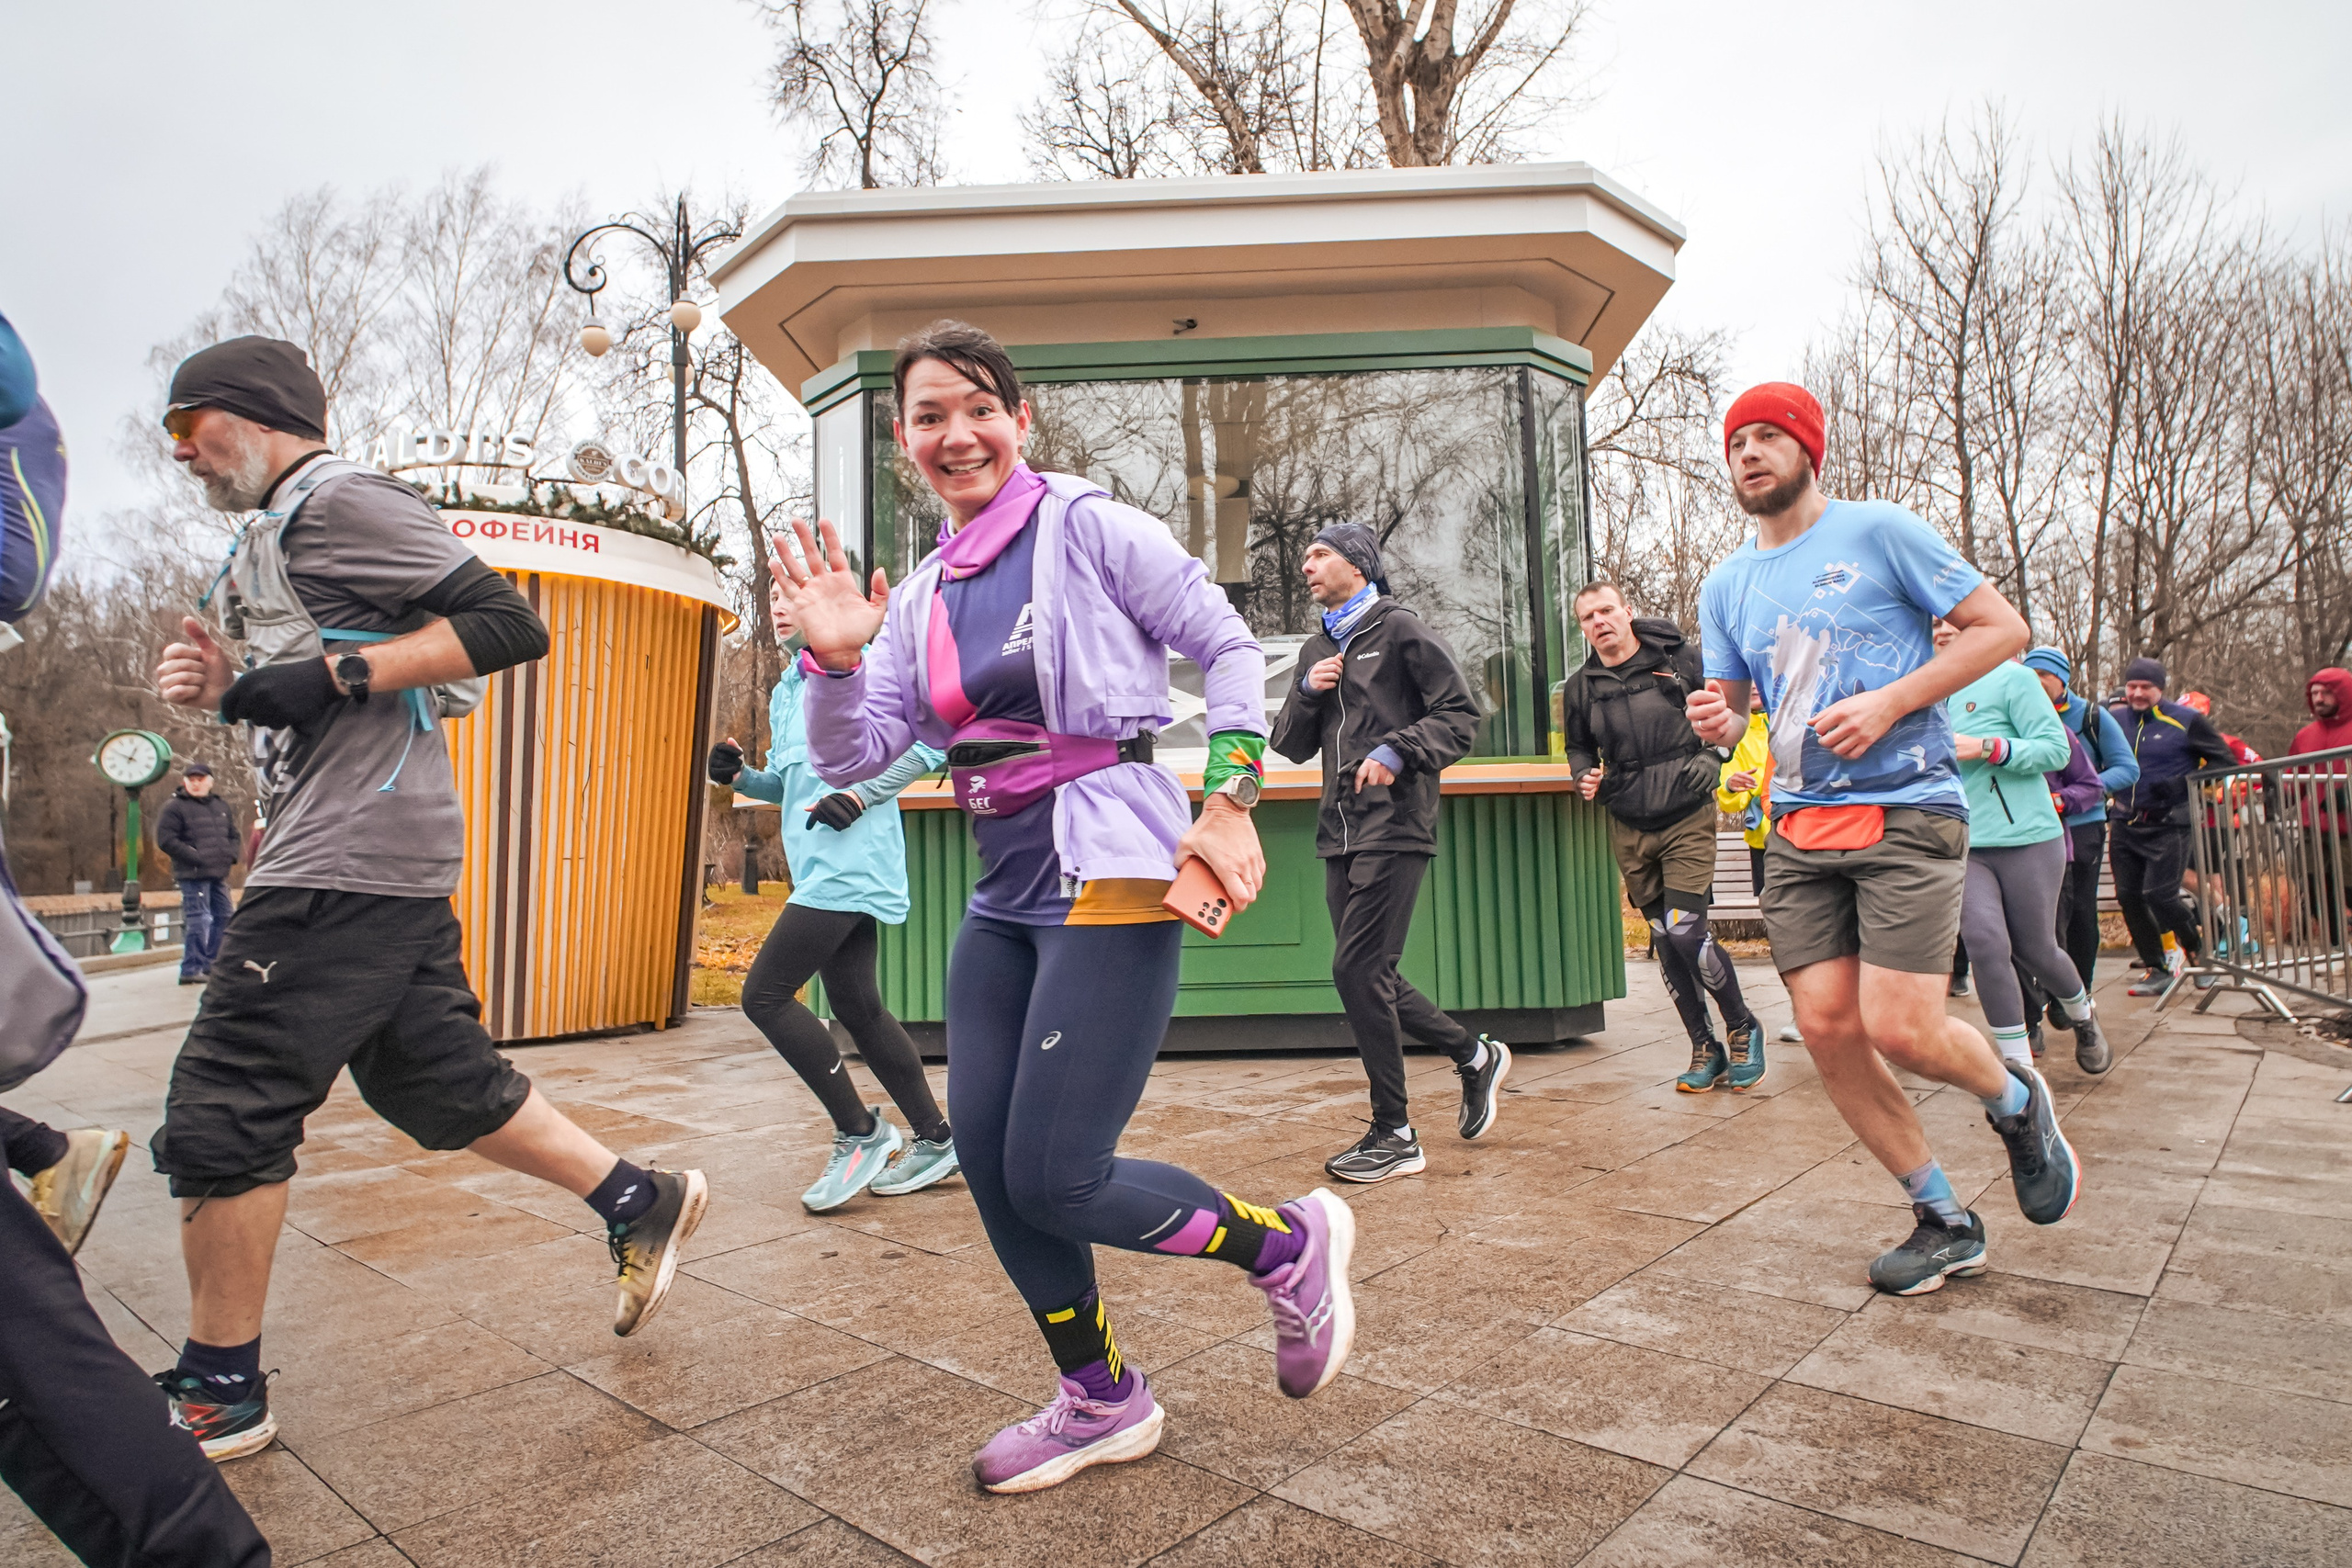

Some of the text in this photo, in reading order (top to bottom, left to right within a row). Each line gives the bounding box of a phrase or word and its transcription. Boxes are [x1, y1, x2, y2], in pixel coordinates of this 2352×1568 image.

[360, 428, 536, 470] ALDI'S
[444, 518, 600, 554] ОФЕЙНЯ
[967, 796, 990, 809] БЕГ
